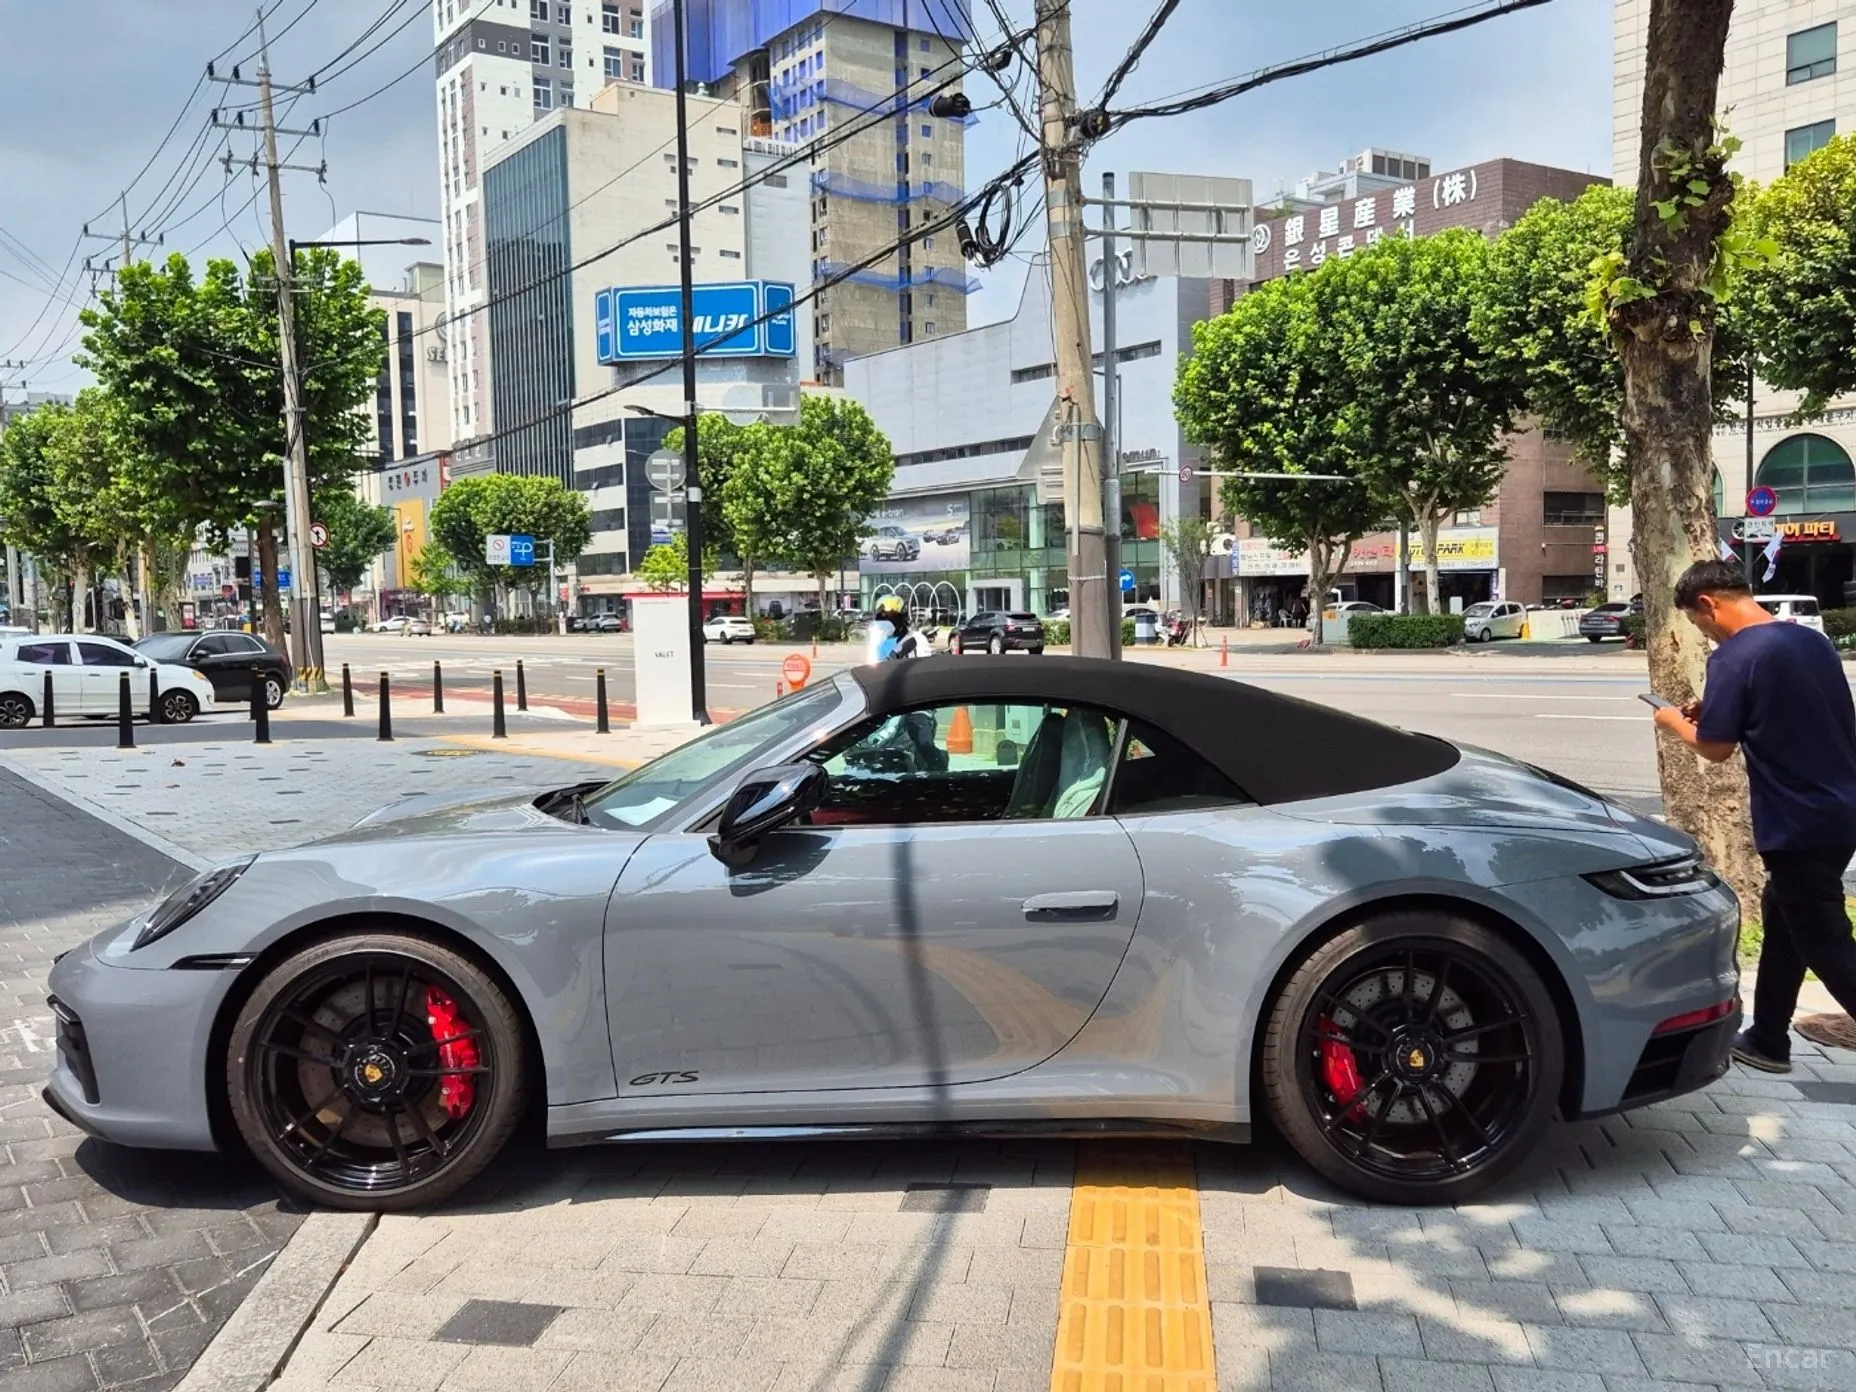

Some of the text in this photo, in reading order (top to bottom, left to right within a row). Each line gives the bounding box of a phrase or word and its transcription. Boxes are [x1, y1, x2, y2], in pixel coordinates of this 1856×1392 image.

[627, 318, 679, 336] 삼성화재
[1437, 542, 1465, 555] PARK
[654, 650, 675, 659] VALET
[628, 1070, 700, 1086] GTS
